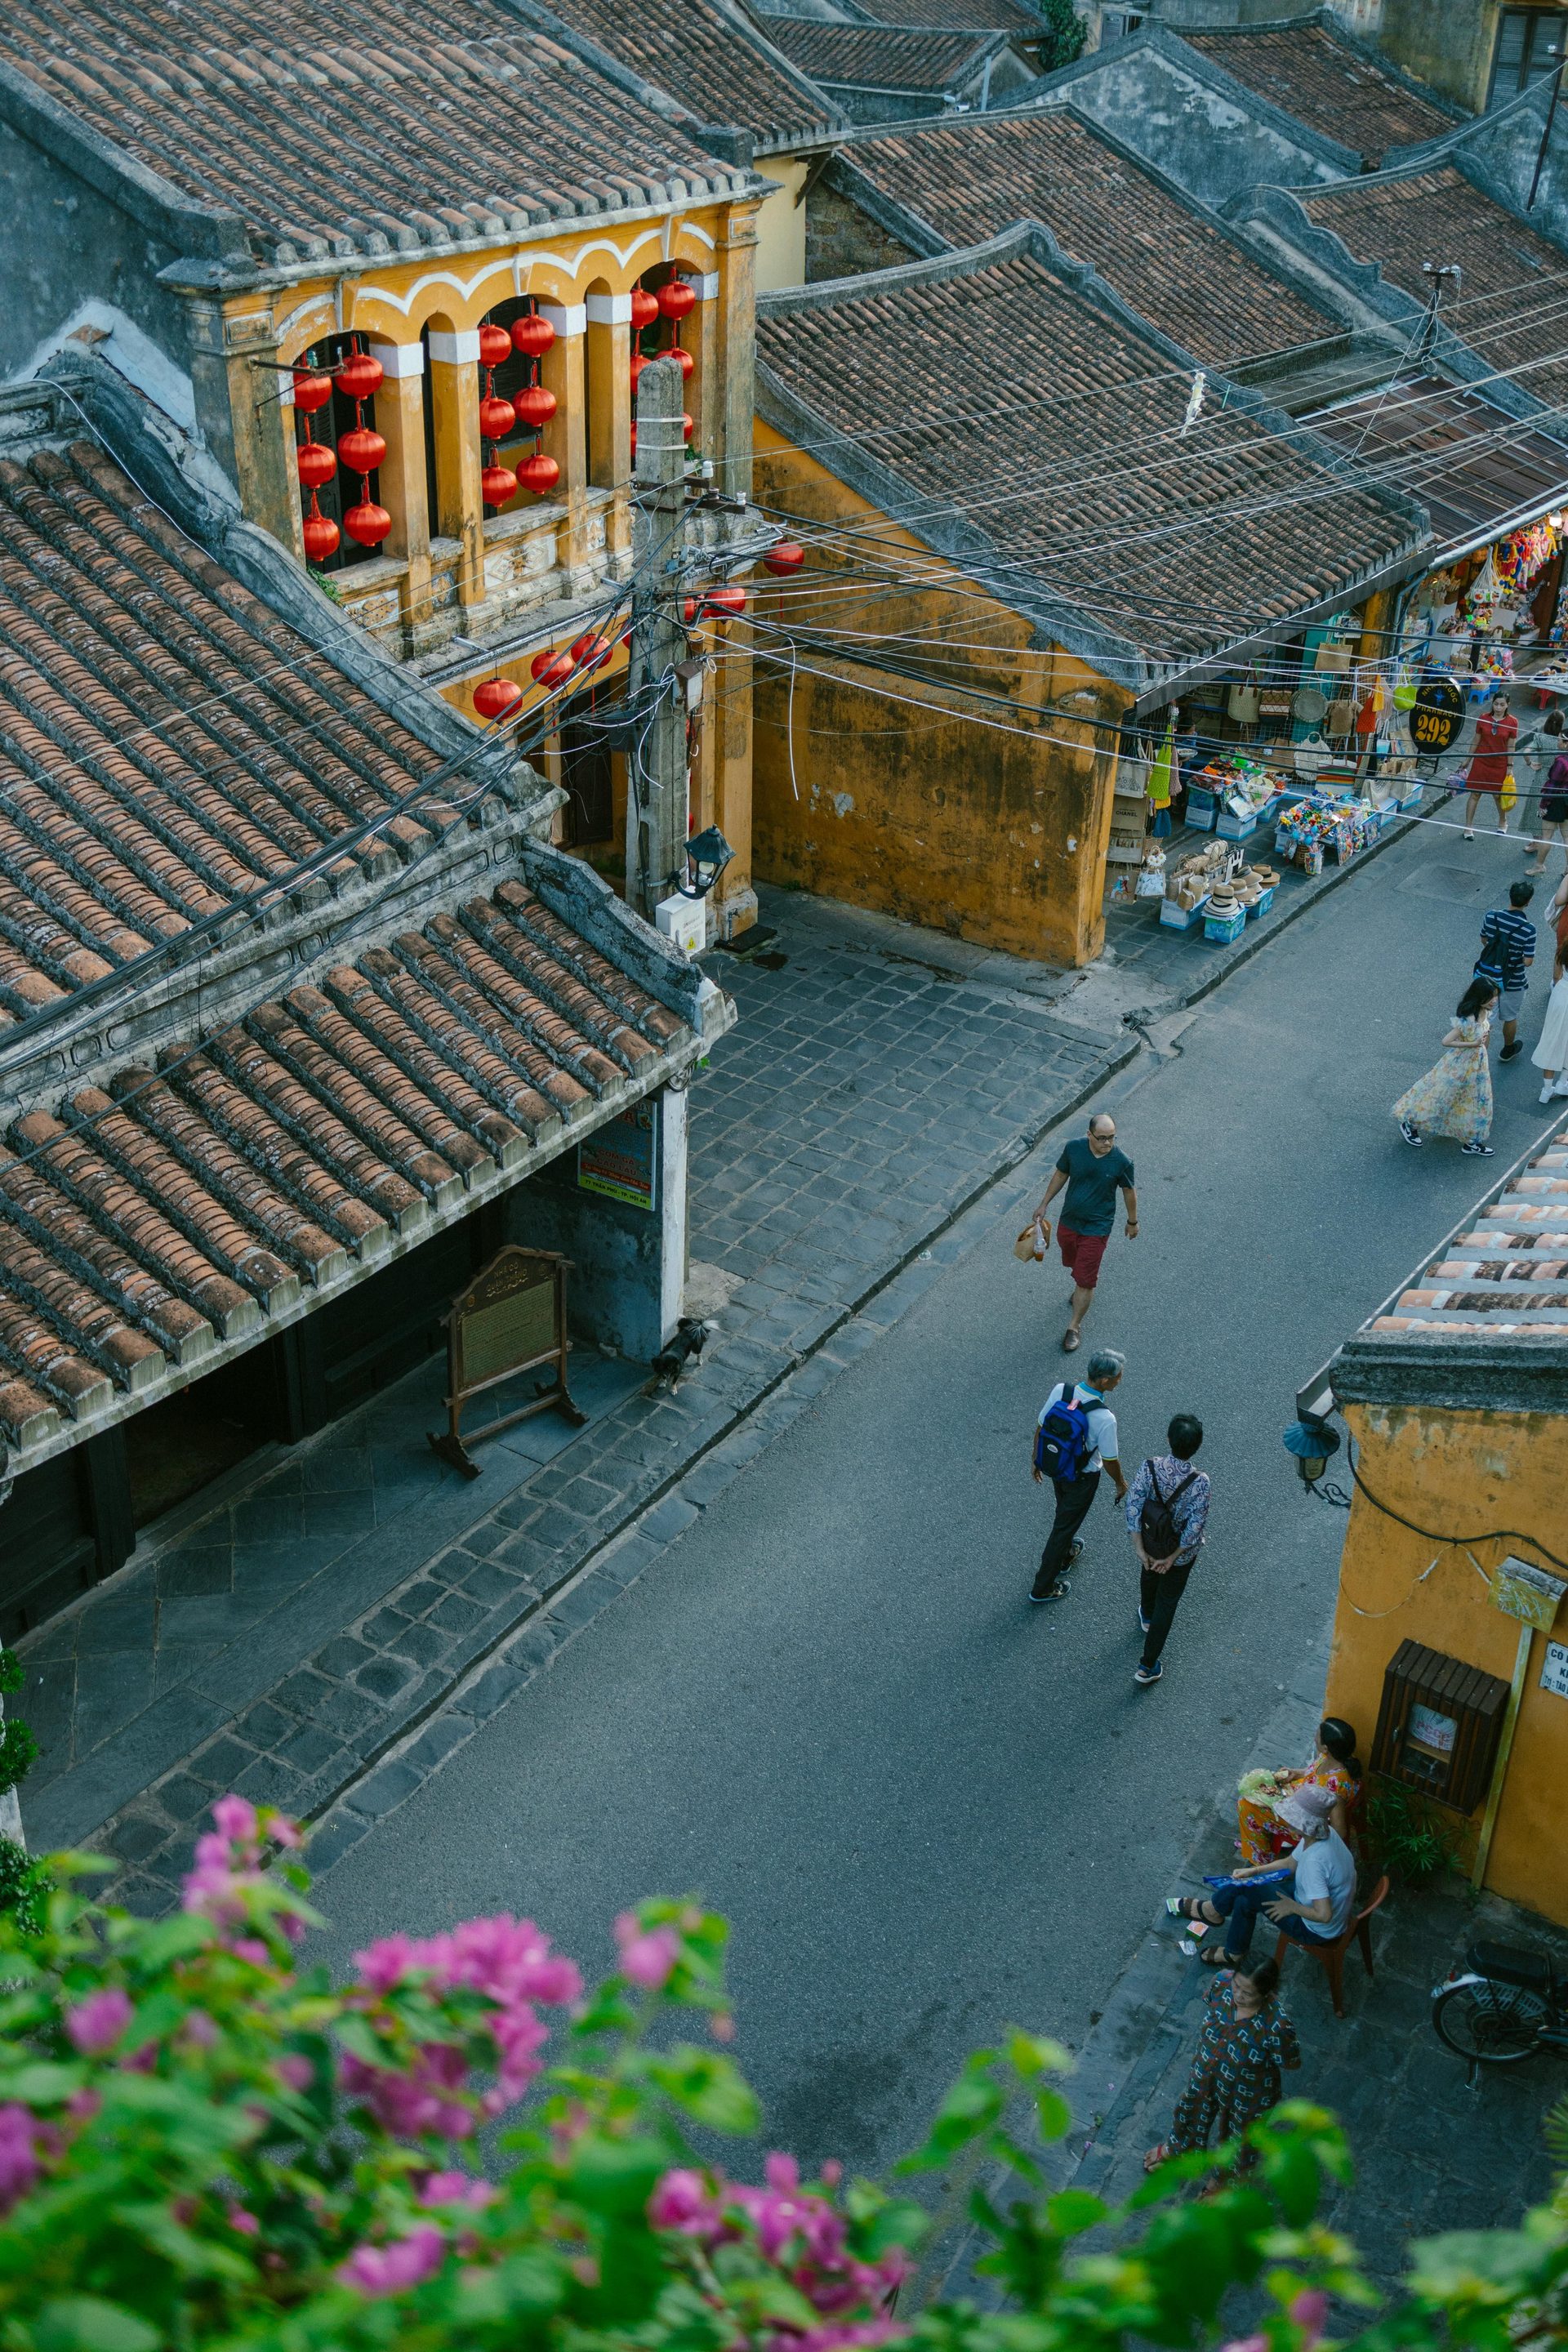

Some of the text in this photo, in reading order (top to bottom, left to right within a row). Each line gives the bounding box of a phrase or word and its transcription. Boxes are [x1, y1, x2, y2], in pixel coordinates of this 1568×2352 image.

[1416, 705, 1458, 718] PHARMACY
[1415, 714, 1451, 746] 292
[1551, 1649, 1563, 1660] CÓ
